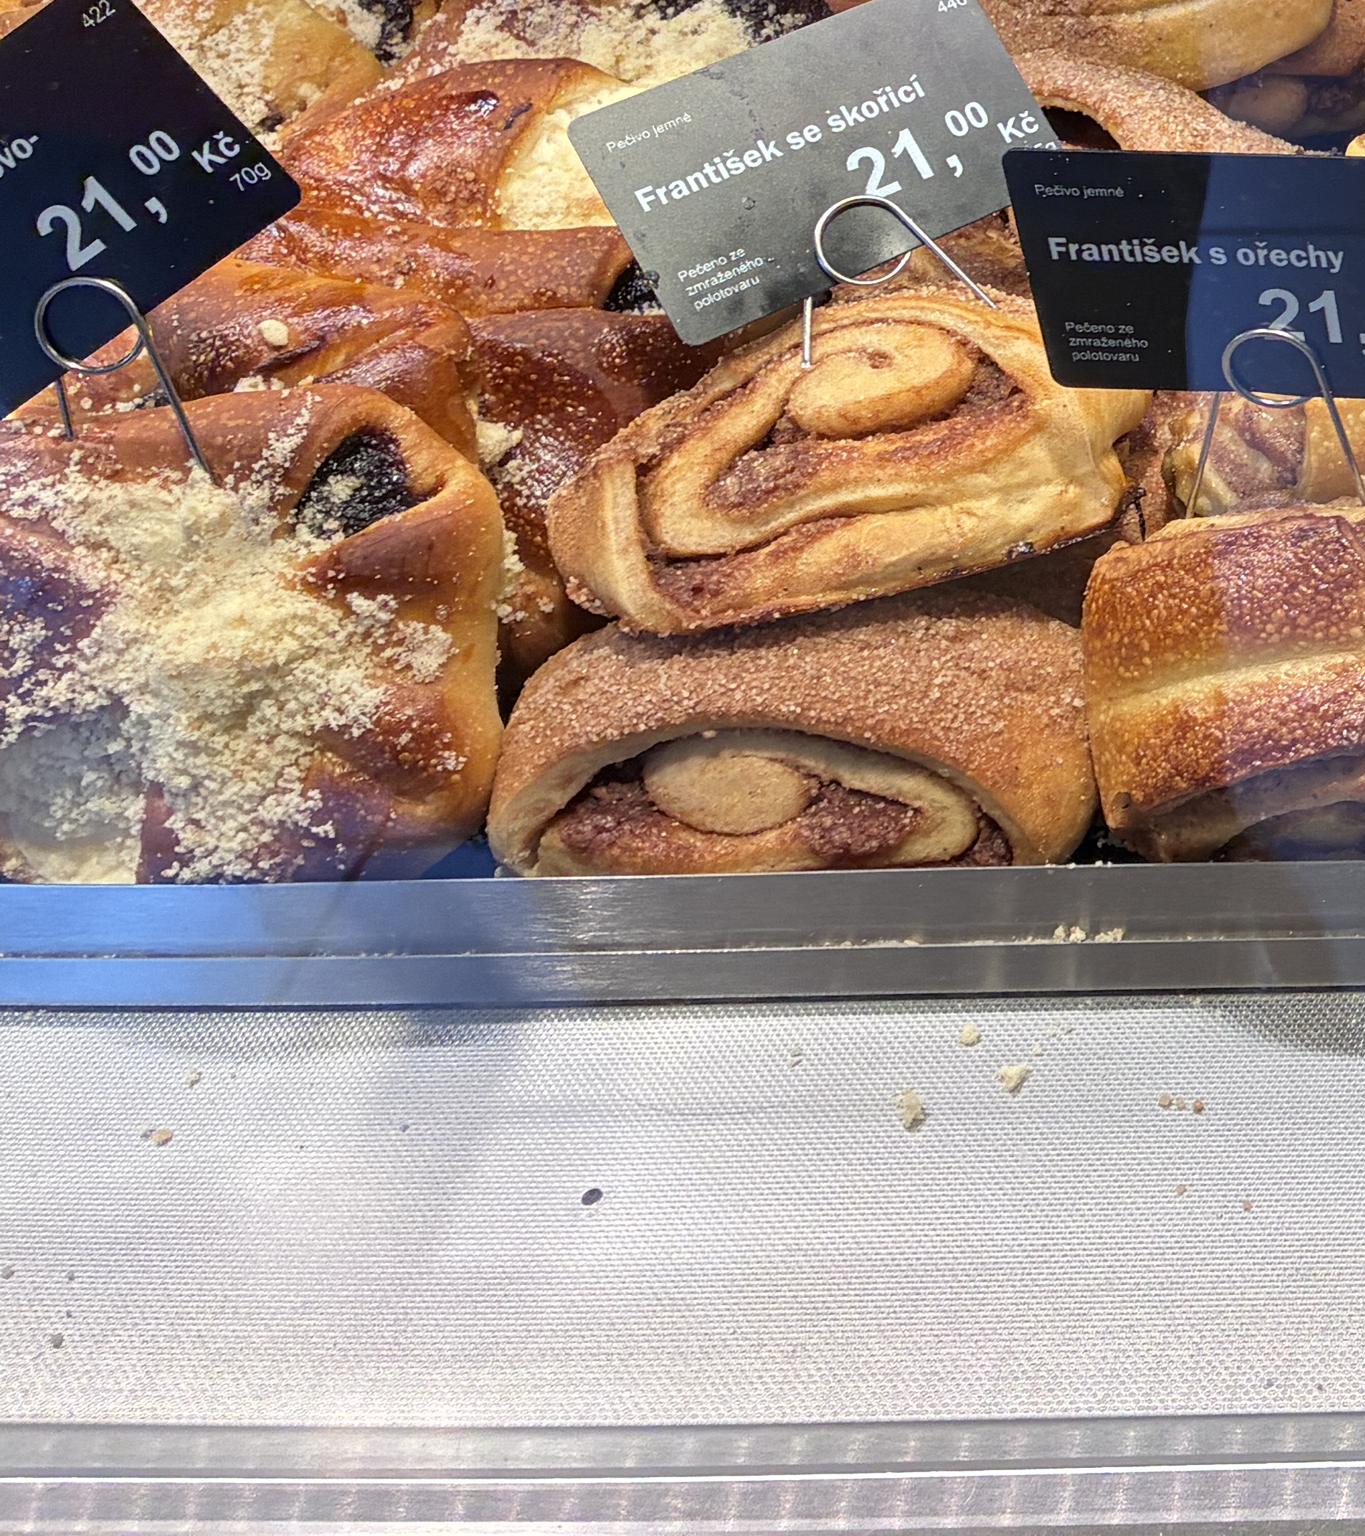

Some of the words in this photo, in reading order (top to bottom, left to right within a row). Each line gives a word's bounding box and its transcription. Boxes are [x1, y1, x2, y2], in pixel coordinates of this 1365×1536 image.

[81, 0, 117, 29] 422
[606, 125, 651, 153] Pečivo
[634, 135, 784, 213] František
[786, 124, 823, 152] se
[827, 74, 927, 130] skořicí
[997, 110, 1039, 144] Kč
[191, 131, 241, 174] Kč
[229, 160, 272, 192] 70g
[677, 252, 729, 284] Pečeno
[732, 247, 747, 261] ze
[1047, 236, 1202, 265] František
[1210, 246, 1227, 265] s
[1236, 241, 1344, 274] ořechy
[686, 256, 764, 298] zmraženého
[694, 275, 760, 312] polotovaru
[1117, 324, 1135, 335] ze
